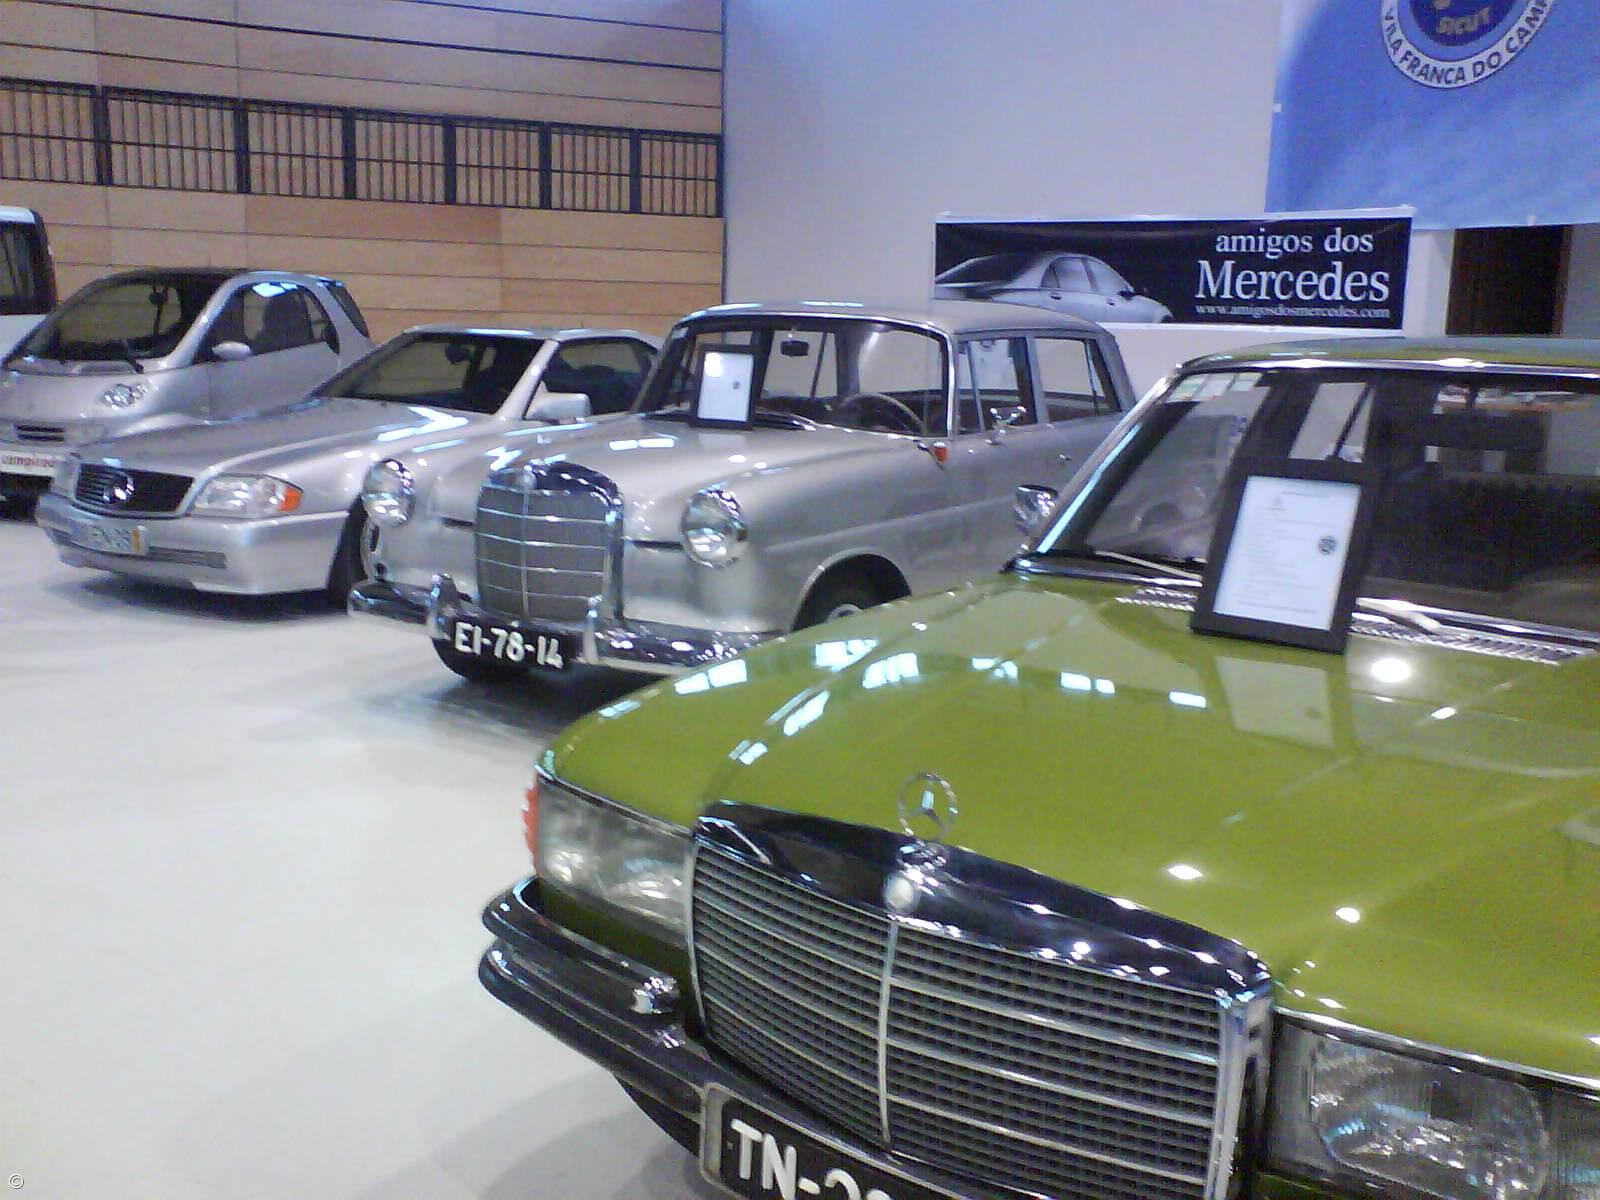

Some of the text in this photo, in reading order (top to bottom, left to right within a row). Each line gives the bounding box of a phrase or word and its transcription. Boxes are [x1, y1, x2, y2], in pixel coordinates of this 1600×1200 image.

[1383, 7, 1402, 53] VILA
[1471, 51, 1501, 78] DO
[1215, 227, 1375, 259] amigos dos
[1194, 259, 1390, 302] Mercedes
[1195, 303, 1391, 319] www.amigosdosmercedes.com
